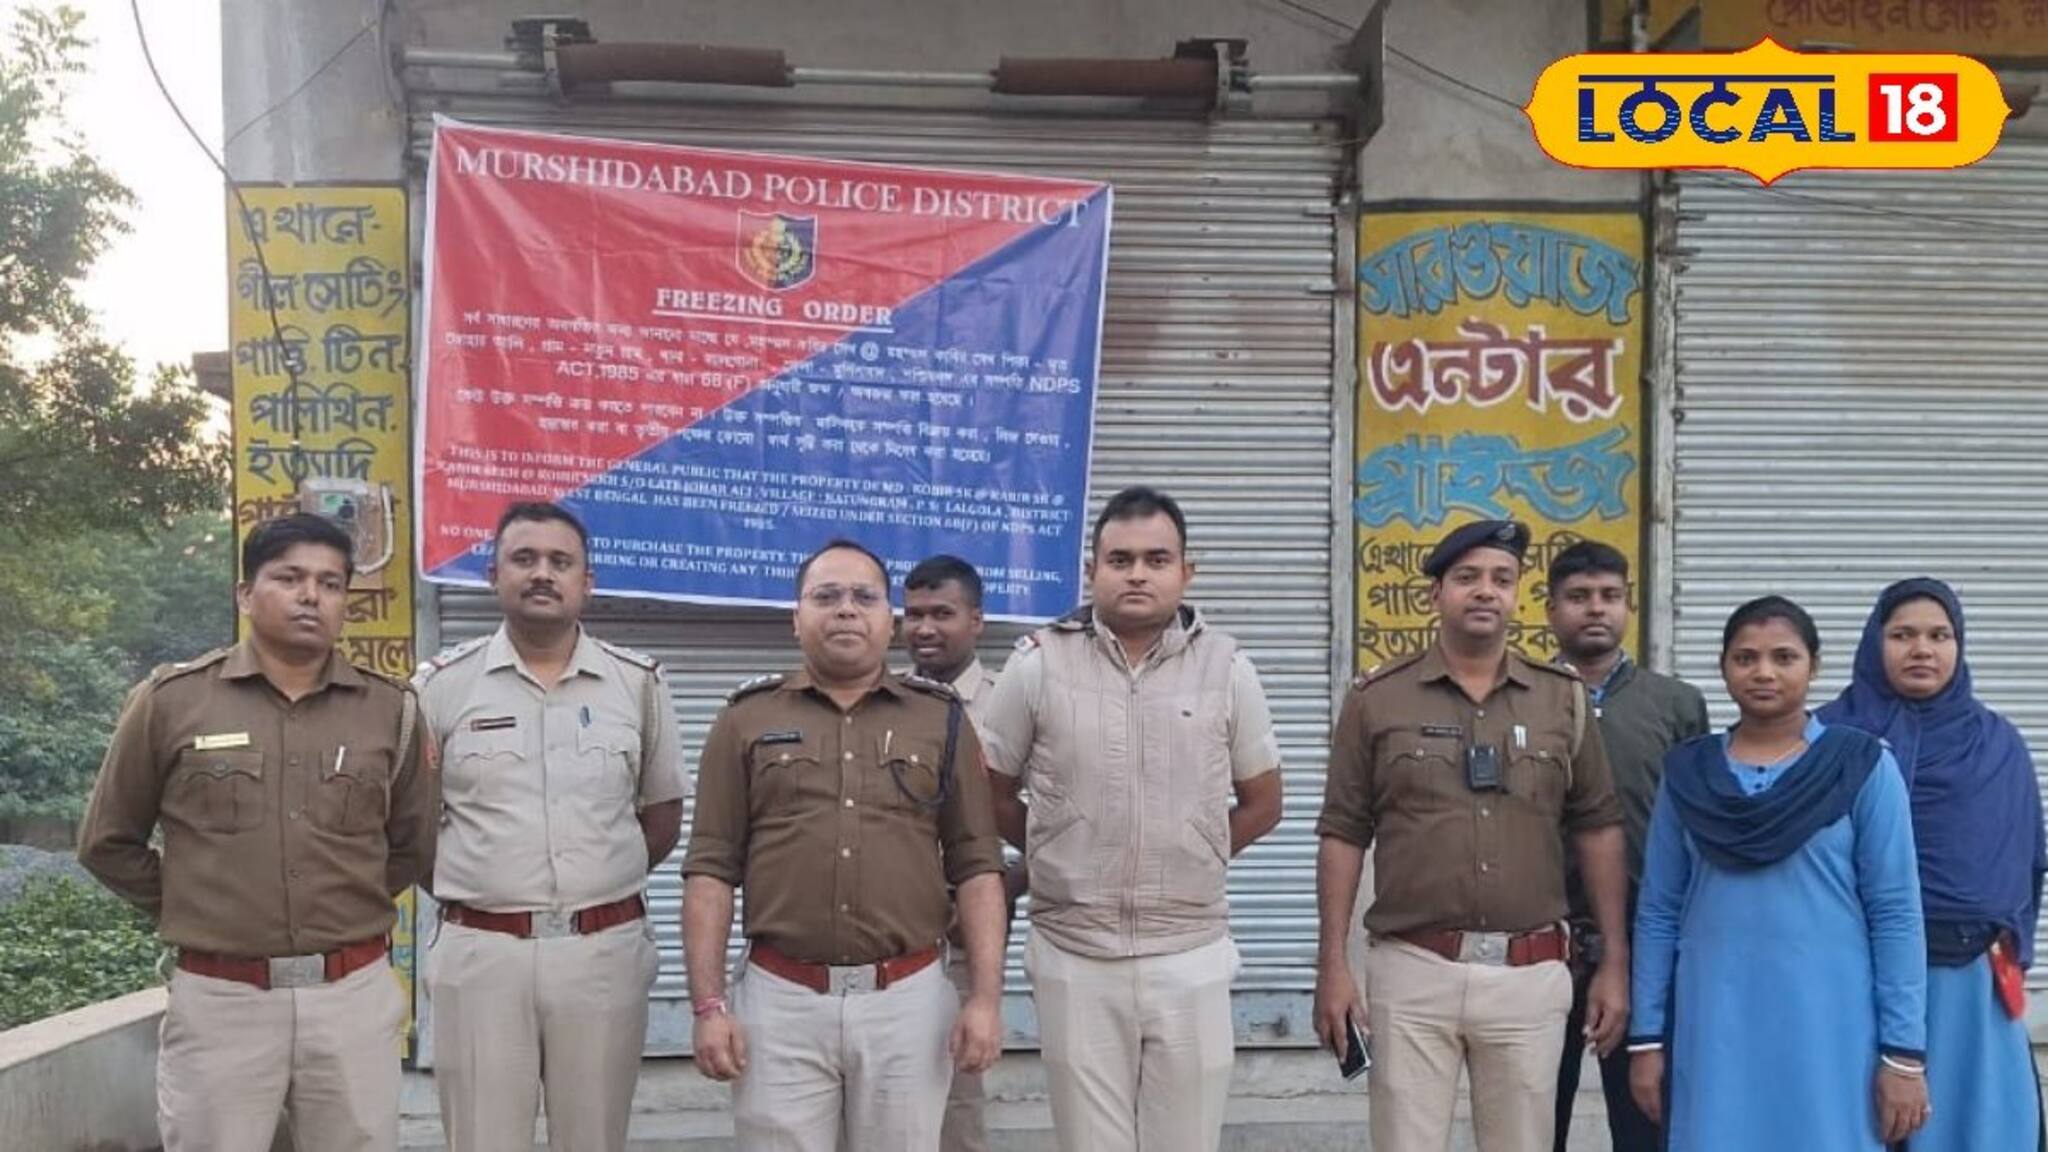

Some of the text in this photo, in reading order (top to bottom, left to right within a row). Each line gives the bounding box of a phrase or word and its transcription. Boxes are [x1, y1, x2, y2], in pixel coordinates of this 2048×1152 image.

[457, 146, 1089, 228] MURSHIDABAD POLICE DISTRICT
[656, 287, 893, 326] FREEZING ORDER
[701, 372, 722, 388] 68
[1028, 376, 1081, 394] NDPS
[451, 444, 481, 461] THIS
[501, 450, 519, 463] TO
[672, 463, 720, 479] PUBLIC
[723, 468, 759, 482] THAT
[763, 471, 788, 485] THE
[791, 474, 861, 490] PROPERTY
[594, 489, 648, 506] BENGAL
[887, 512, 941, 528] SECTION
[1038, 523, 1064, 537] ACT
[440, 523, 461, 537] NO
[592, 536, 611, 550] TO
[614, 538, 682, 555] PURCHASE
[687, 543, 712, 557] THE
[716, 545, 785, 563] PROPERTY
[639, 555, 658, 570] OR
[661, 557, 727, 574] CREATING
